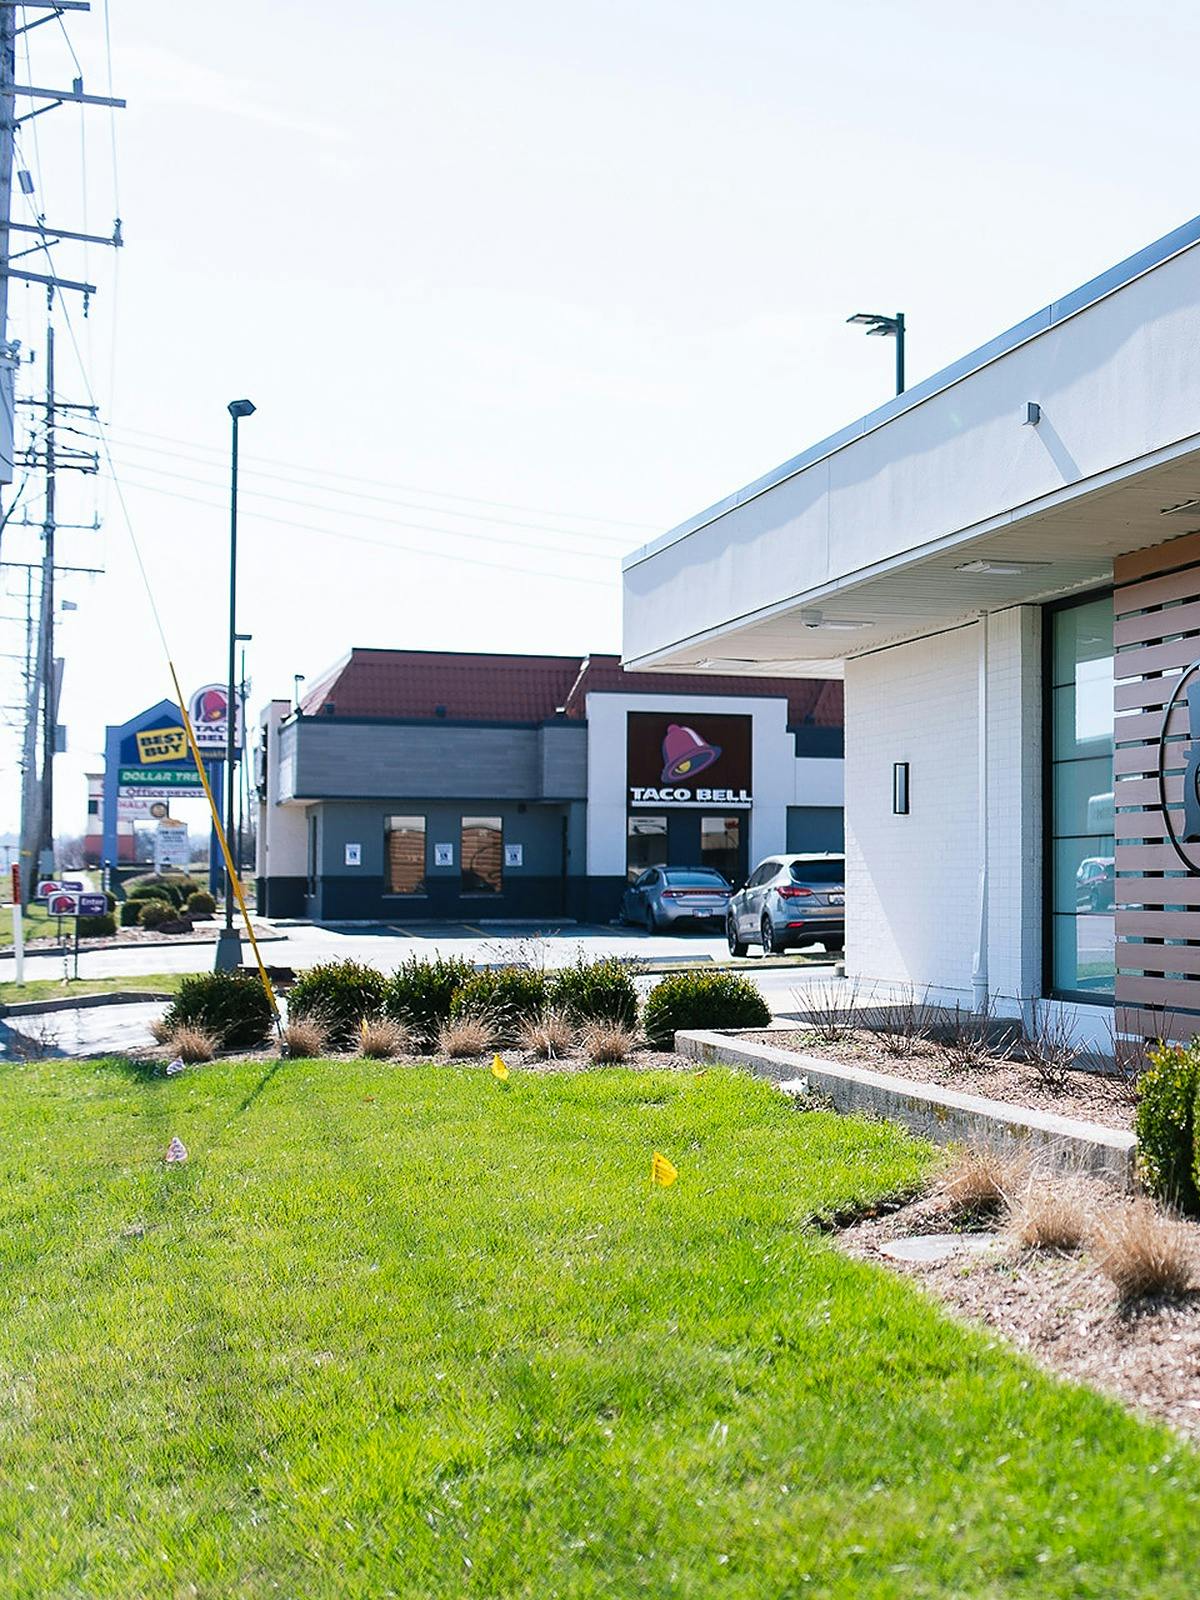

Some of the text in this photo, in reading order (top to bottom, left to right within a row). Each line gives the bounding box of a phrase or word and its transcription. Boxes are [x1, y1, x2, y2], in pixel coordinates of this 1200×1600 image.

[140, 732, 184, 746] BEST
[196, 734, 239, 742] BEL
[144, 744, 182, 757] BUY
[122, 772, 172, 781] DOLLAR
[630, 787, 753, 802] TACO BELL
[82, 898, 104, 906] Enter
